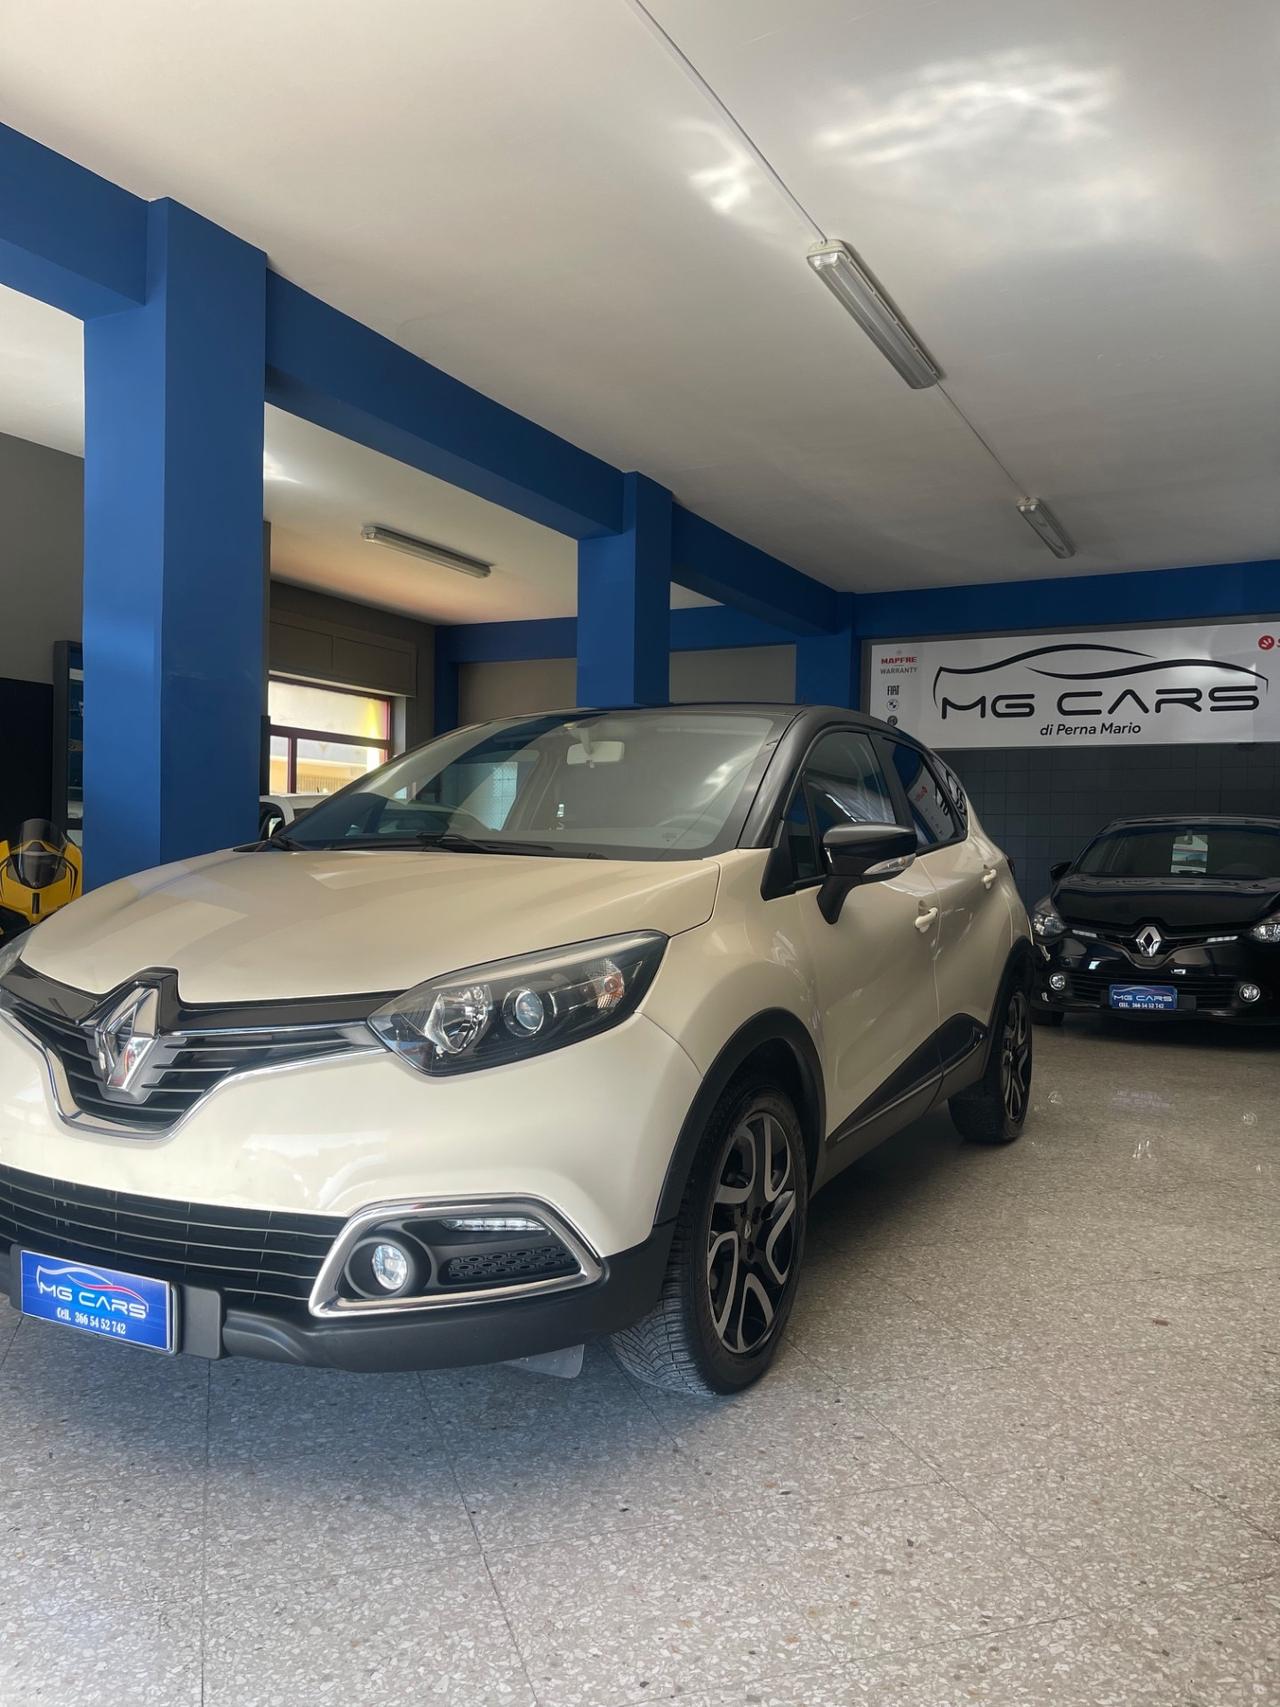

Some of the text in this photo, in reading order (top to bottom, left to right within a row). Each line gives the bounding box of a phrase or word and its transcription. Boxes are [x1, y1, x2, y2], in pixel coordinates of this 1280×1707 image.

[881, 656, 917, 665] MAPFRE
[887, 685, 900, 696] FIAT
[941, 685, 1260, 720] MG CARS
[1039, 722, 1142, 736] di Perna Mario
[40, 1282, 147, 1319] MG CARS
[74, 1311, 89, 1326] 366
[89, 1315, 100, 1328] 54
[100, 1318, 111, 1331] 52
[111, 1320, 127, 1335] 742
